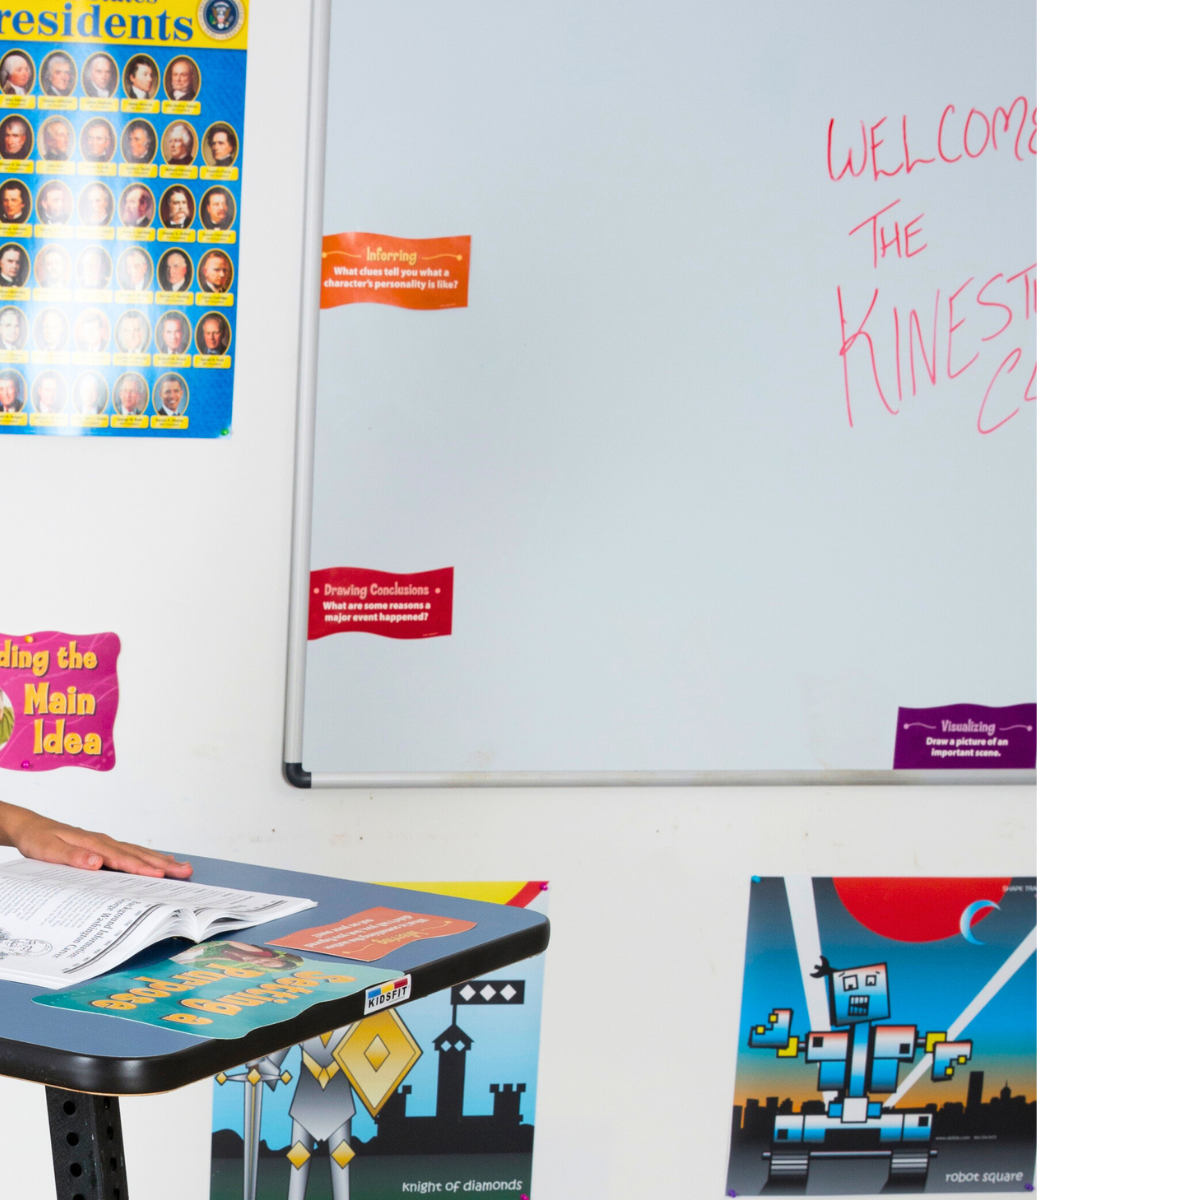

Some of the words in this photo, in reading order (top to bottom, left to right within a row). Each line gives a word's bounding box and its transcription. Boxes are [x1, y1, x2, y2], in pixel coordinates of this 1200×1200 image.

[848, 198, 928, 269] THE
[366, 246, 417, 266] Inferring
[334, 267, 358, 276] What
[359, 267, 382, 276] clues
[384, 267, 399, 276] tell
[401, 269, 417, 278] you
[420, 268, 441, 277] what
[324, 279, 373, 288] character's
[375, 280, 426, 291] personality
[428, 280, 435, 288] is
[437, 280, 458, 289] like?
[837, 263, 1037, 428] KINEST
[324, 583, 367, 600] Drawing
[370, 581, 429, 596] Conclusions
[323, 602, 347, 610] What
[325, 613, 351, 623] major
[379, 612, 429, 623] happened?
[57, 641, 98, 669] the
[24, 682, 96, 715] Main
[941, 718, 996, 736] Visualizing
[33, 718, 102, 755] Idea
[926, 737, 948, 746] Draw
[956, 737, 986, 747] picture
[987, 737, 997, 746] of
[931, 748, 974, 758] important
[91, 963, 265, 1010] Purpose
[180, 970, 357, 1016] Setting
[368, 986, 407, 1008] KIDSFIT
[161, 1013, 213, 1025] a
[402, 1181, 442, 1194] knight
[445, 1181, 461, 1192] of
[463, 1179, 523, 1191] diamonds
[945, 1171, 980, 1183] robot
[982, 1171, 1023, 1184] square
